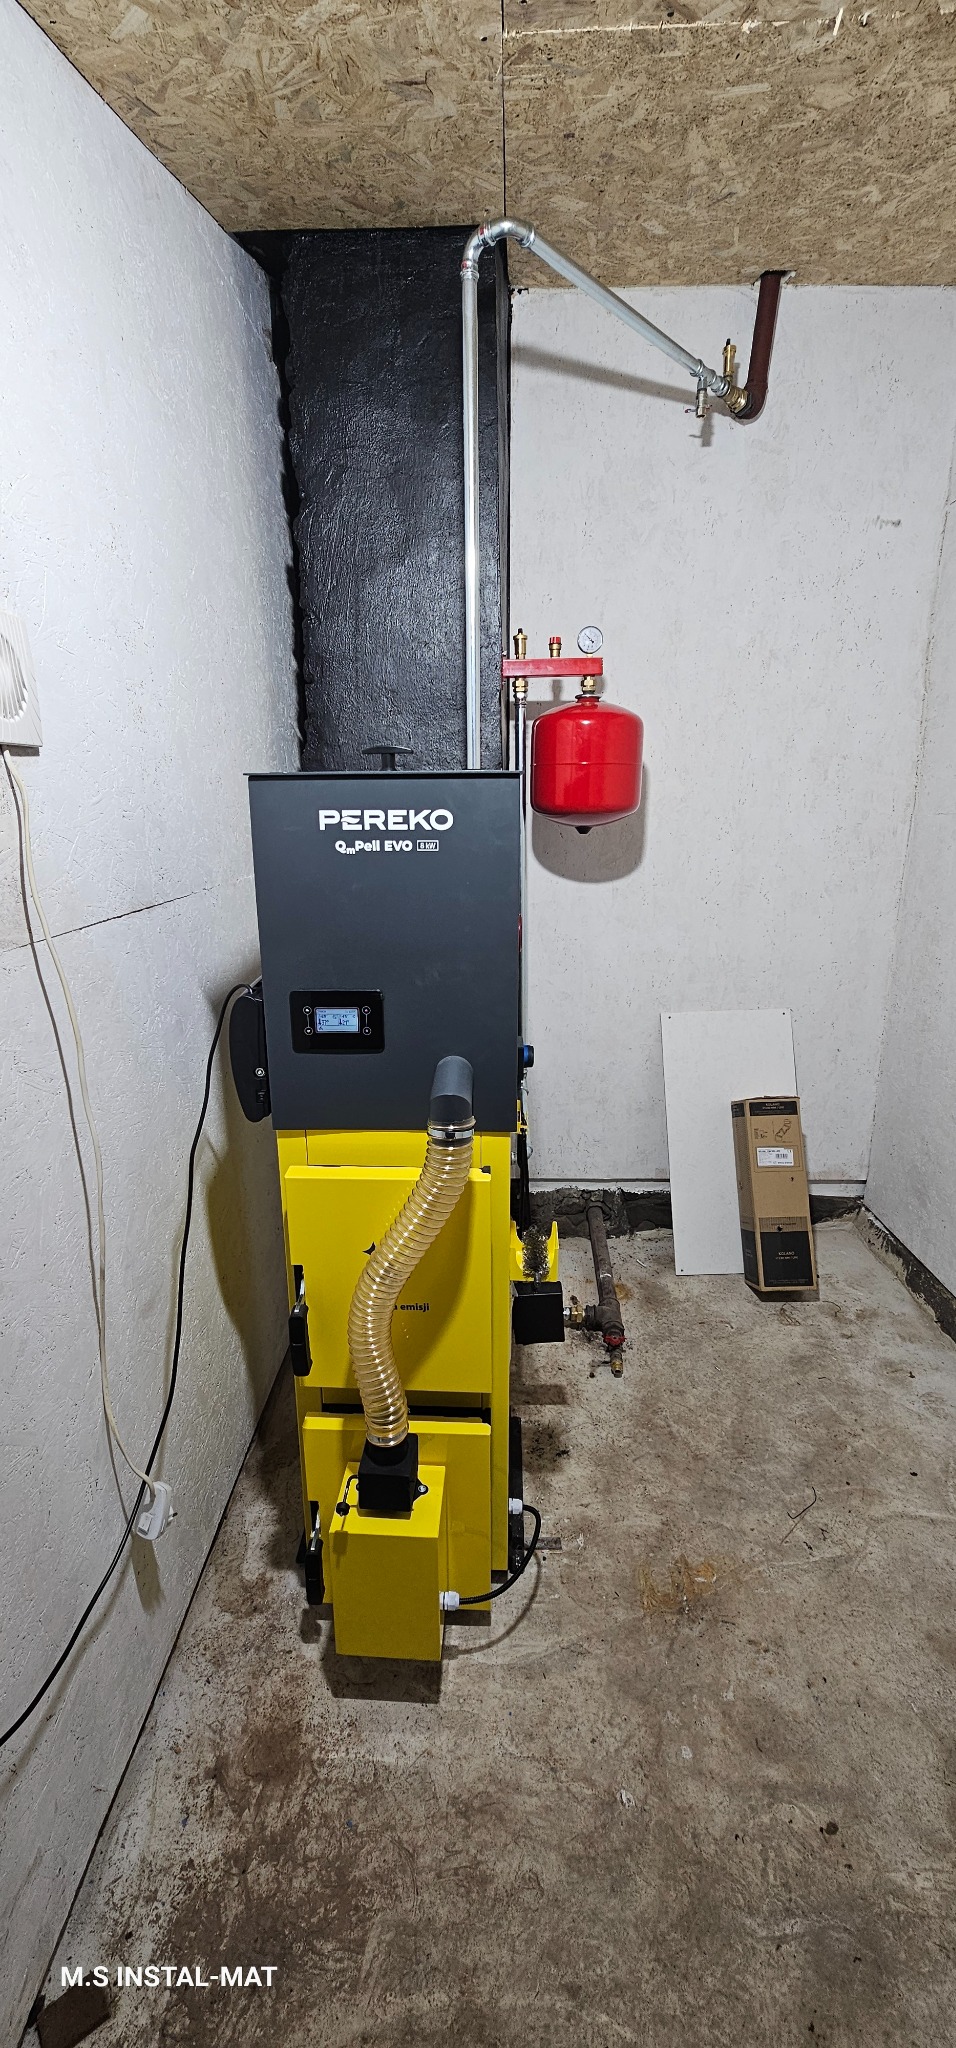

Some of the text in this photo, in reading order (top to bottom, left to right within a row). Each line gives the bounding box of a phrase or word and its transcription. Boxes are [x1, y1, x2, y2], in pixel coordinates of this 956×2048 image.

[319, 809, 454, 831] PEREKO
[384, 840, 413, 852] EVO
[400, 1302, 429, 1312] emisji
